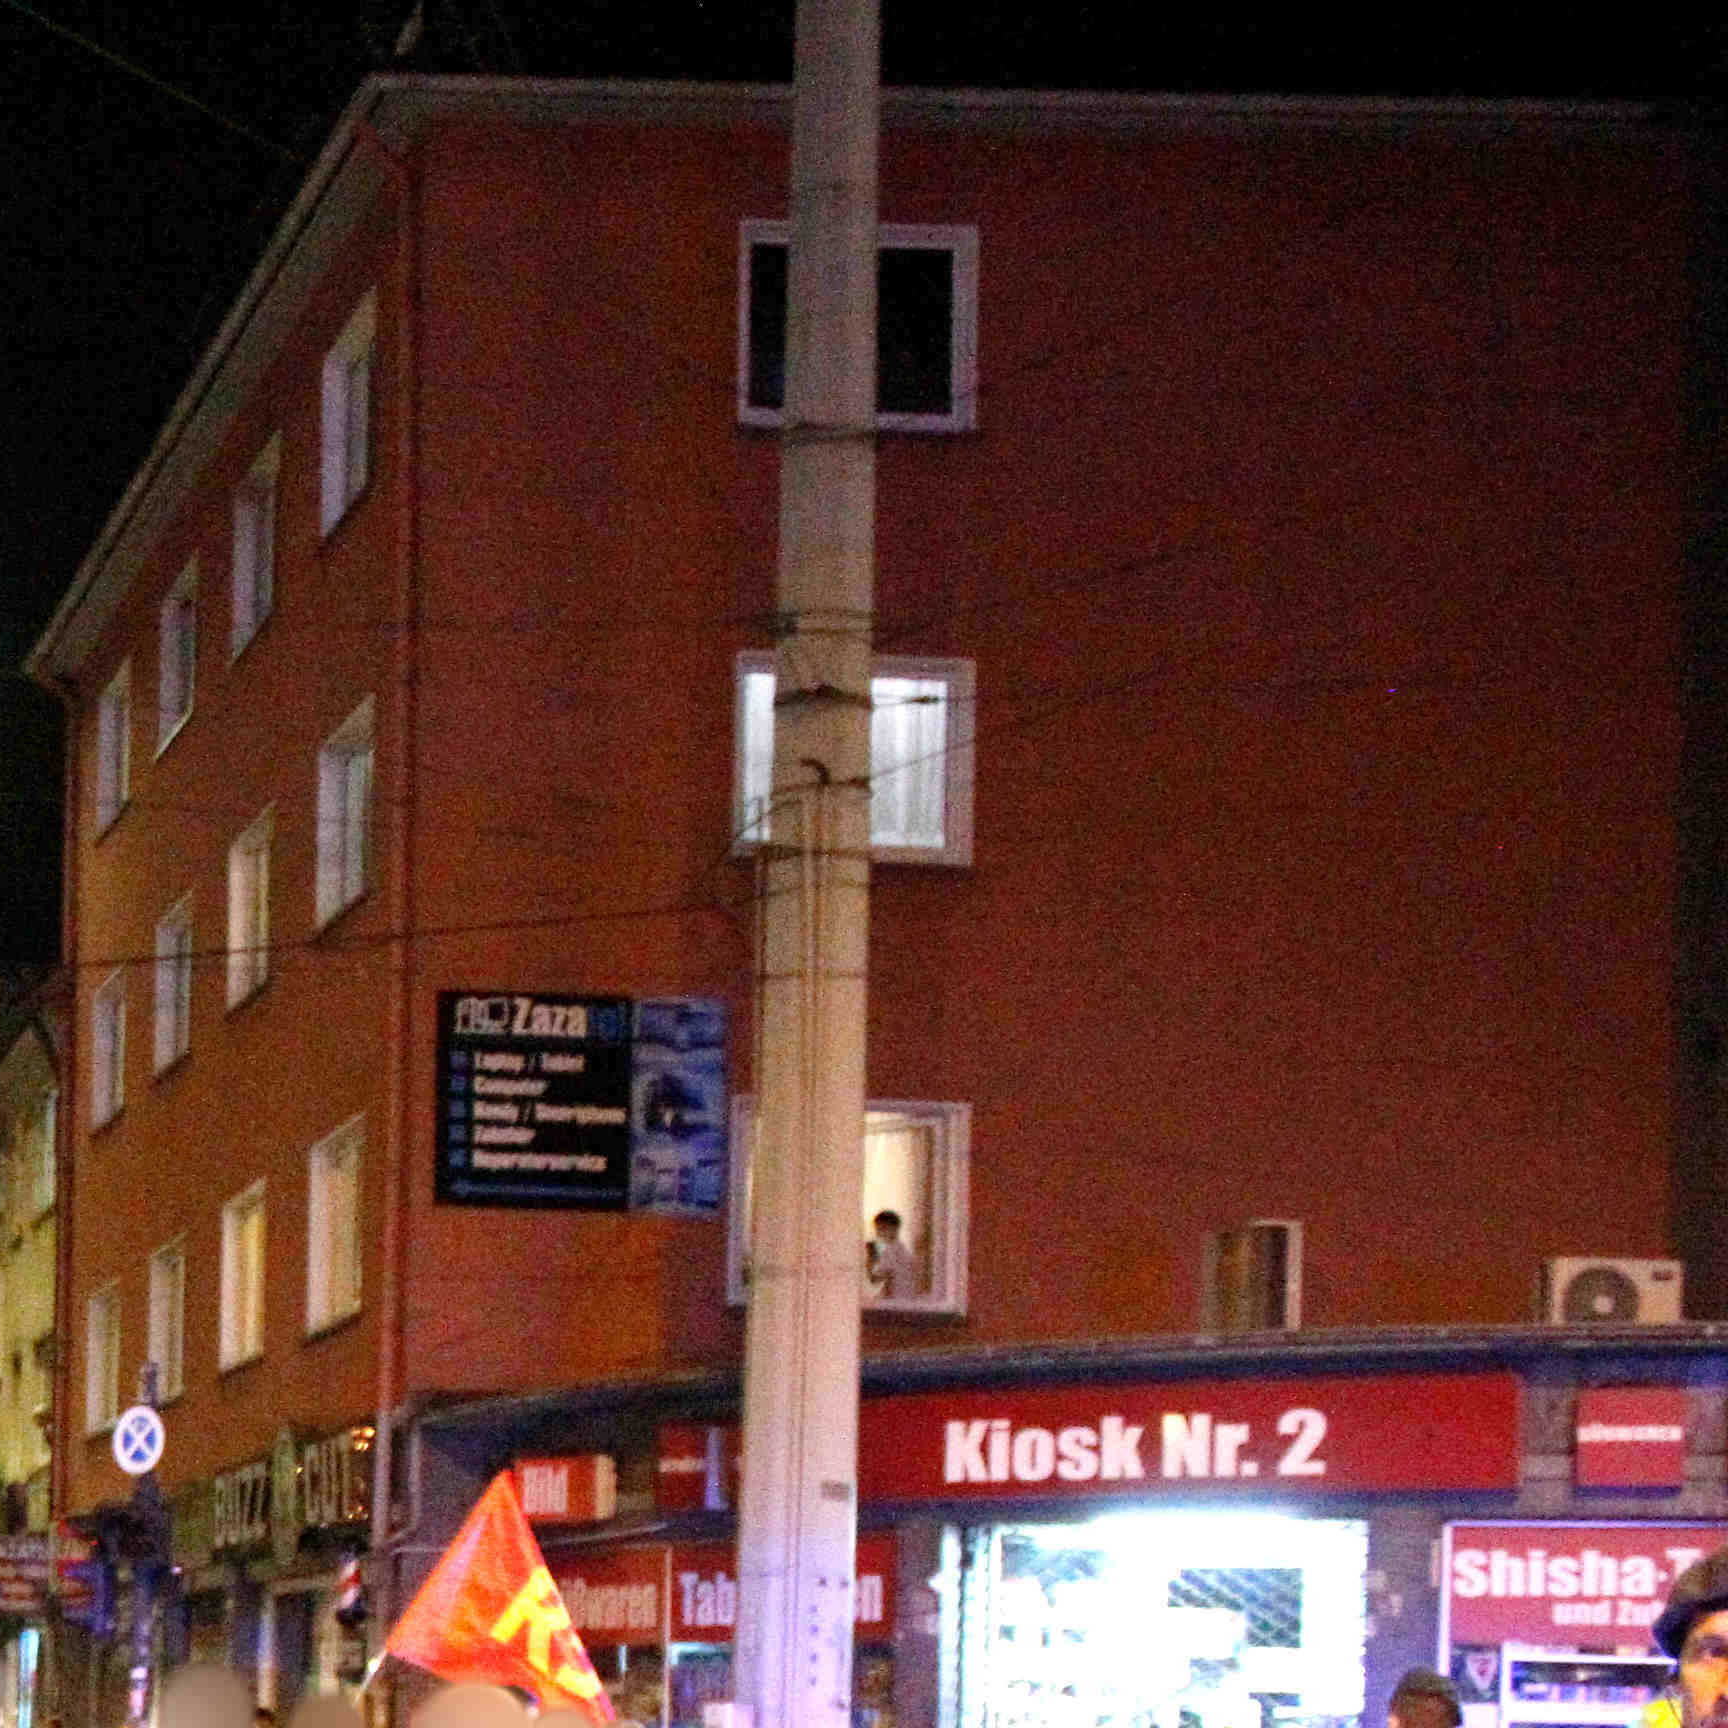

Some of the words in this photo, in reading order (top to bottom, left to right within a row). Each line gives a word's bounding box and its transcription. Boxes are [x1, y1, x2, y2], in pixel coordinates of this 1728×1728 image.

[944, 1413, 1144, 1484] Kiosk
[1161, 1413, 1259, 1481] Nr.
[1277, 1407, 1328, 1477] 2
[1552, 1601, 1611, 1626] und
